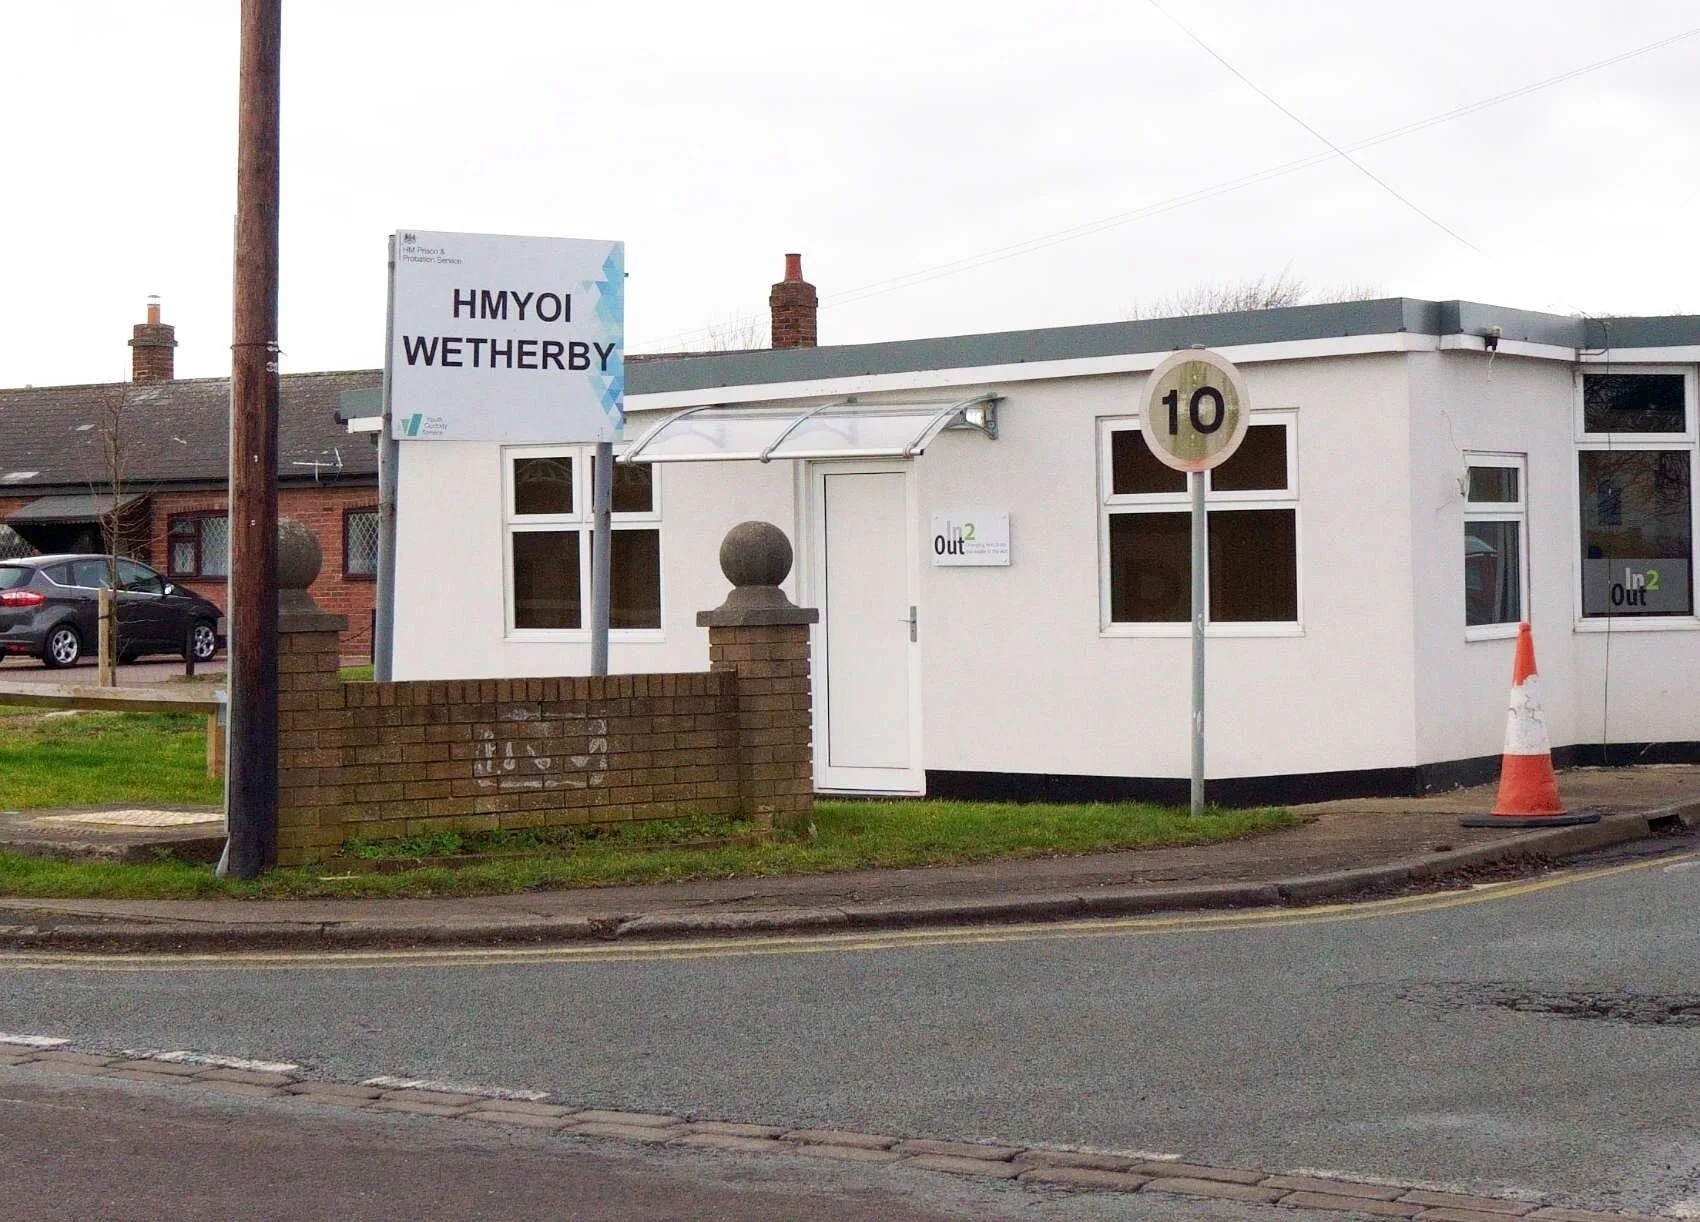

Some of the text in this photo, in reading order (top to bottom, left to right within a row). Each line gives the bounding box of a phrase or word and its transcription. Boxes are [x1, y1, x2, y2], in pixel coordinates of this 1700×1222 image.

[453, 288, 571, 323] HMYOI
[402, 335, 616, 372] WETHERBY
[1162, 386, 1225, 435] 10
[934, 534, 965, 555] Out
[1611, 583, 1647, 606] Out
